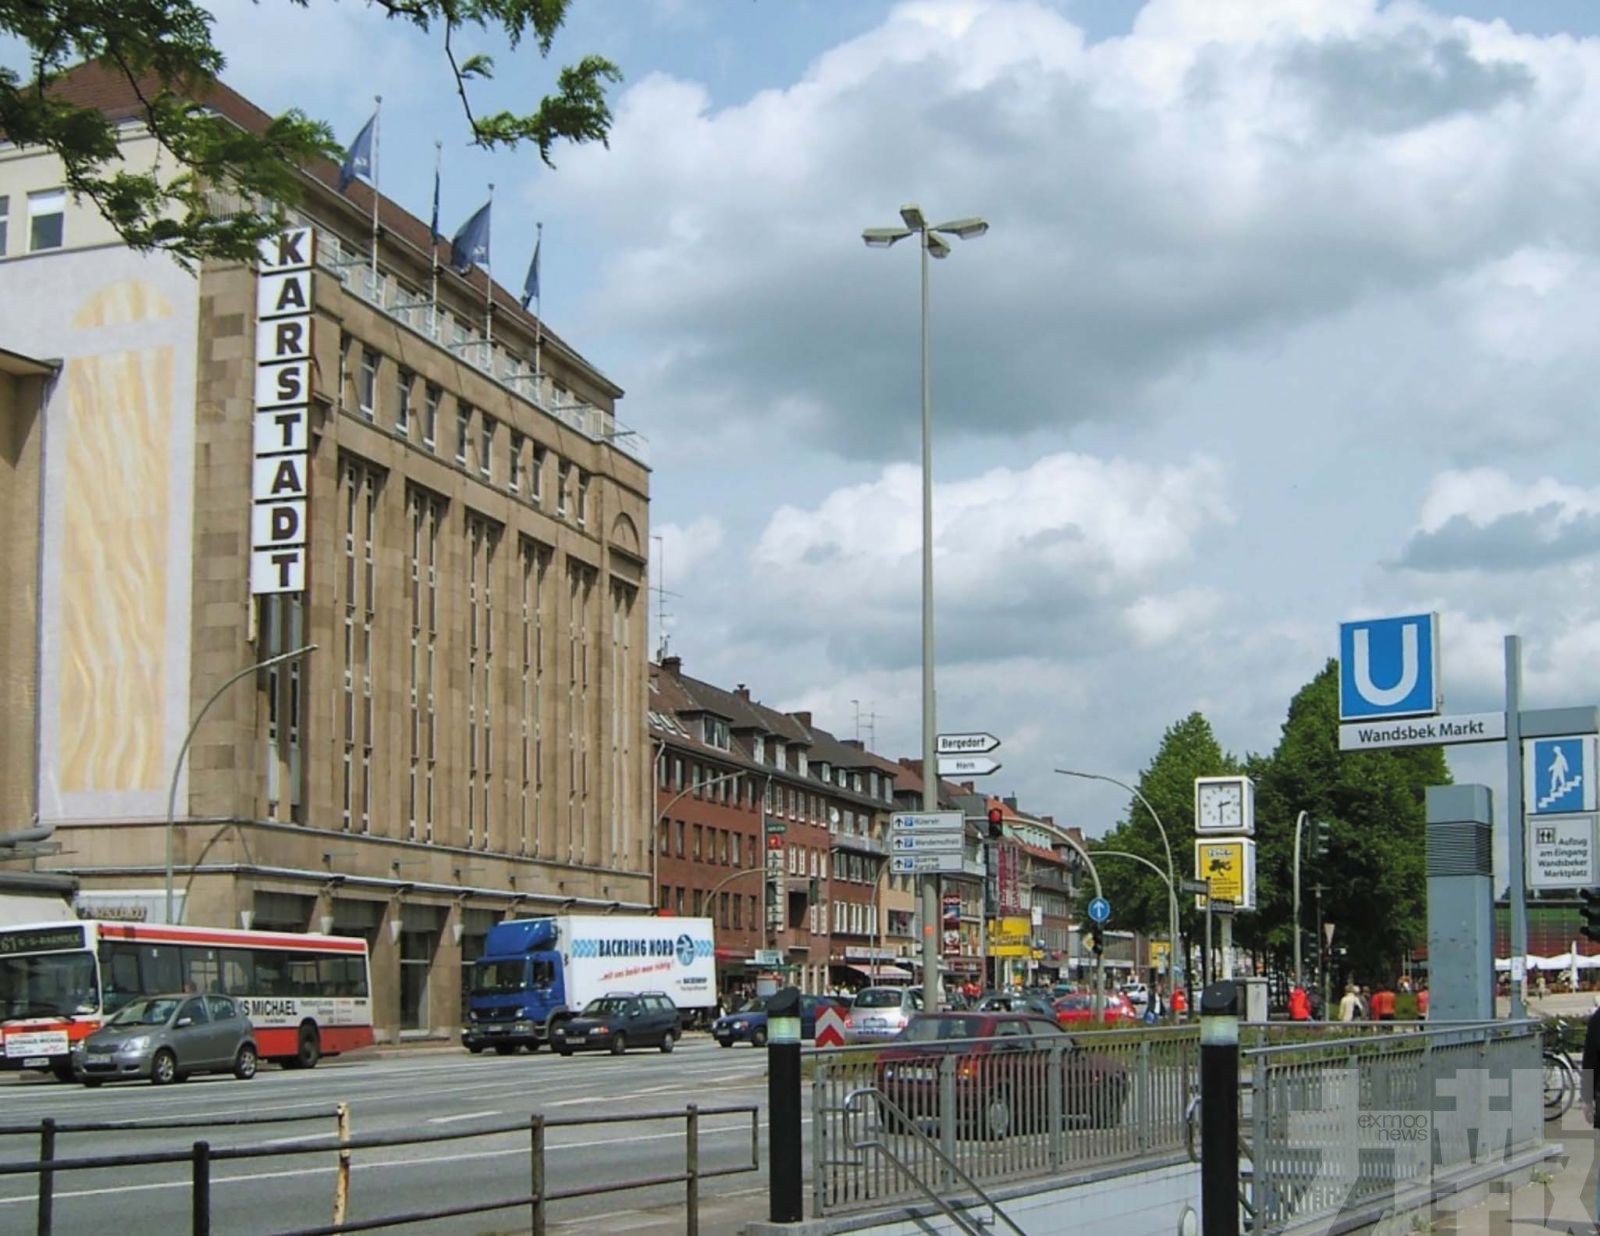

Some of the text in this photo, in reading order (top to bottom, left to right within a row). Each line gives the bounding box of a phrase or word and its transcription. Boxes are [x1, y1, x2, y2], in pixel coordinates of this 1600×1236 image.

[271, 231, 306, 588] KARSTADT
[1353, 624, 1418, 706] U
[1358, 721, 1485, 743] Wandsbek Markt
[942, 737, 985, 749] Bergedorf
[1558, 837, 1587, 847] Aufzug
[1554, 849, 1587, 857] Eingang
[1544, 869, 1587, 878] Marktplatz
[599, 939, 674, 957] BACKRING NORD
[252, 1000, 297, 1016] MICHAEL
